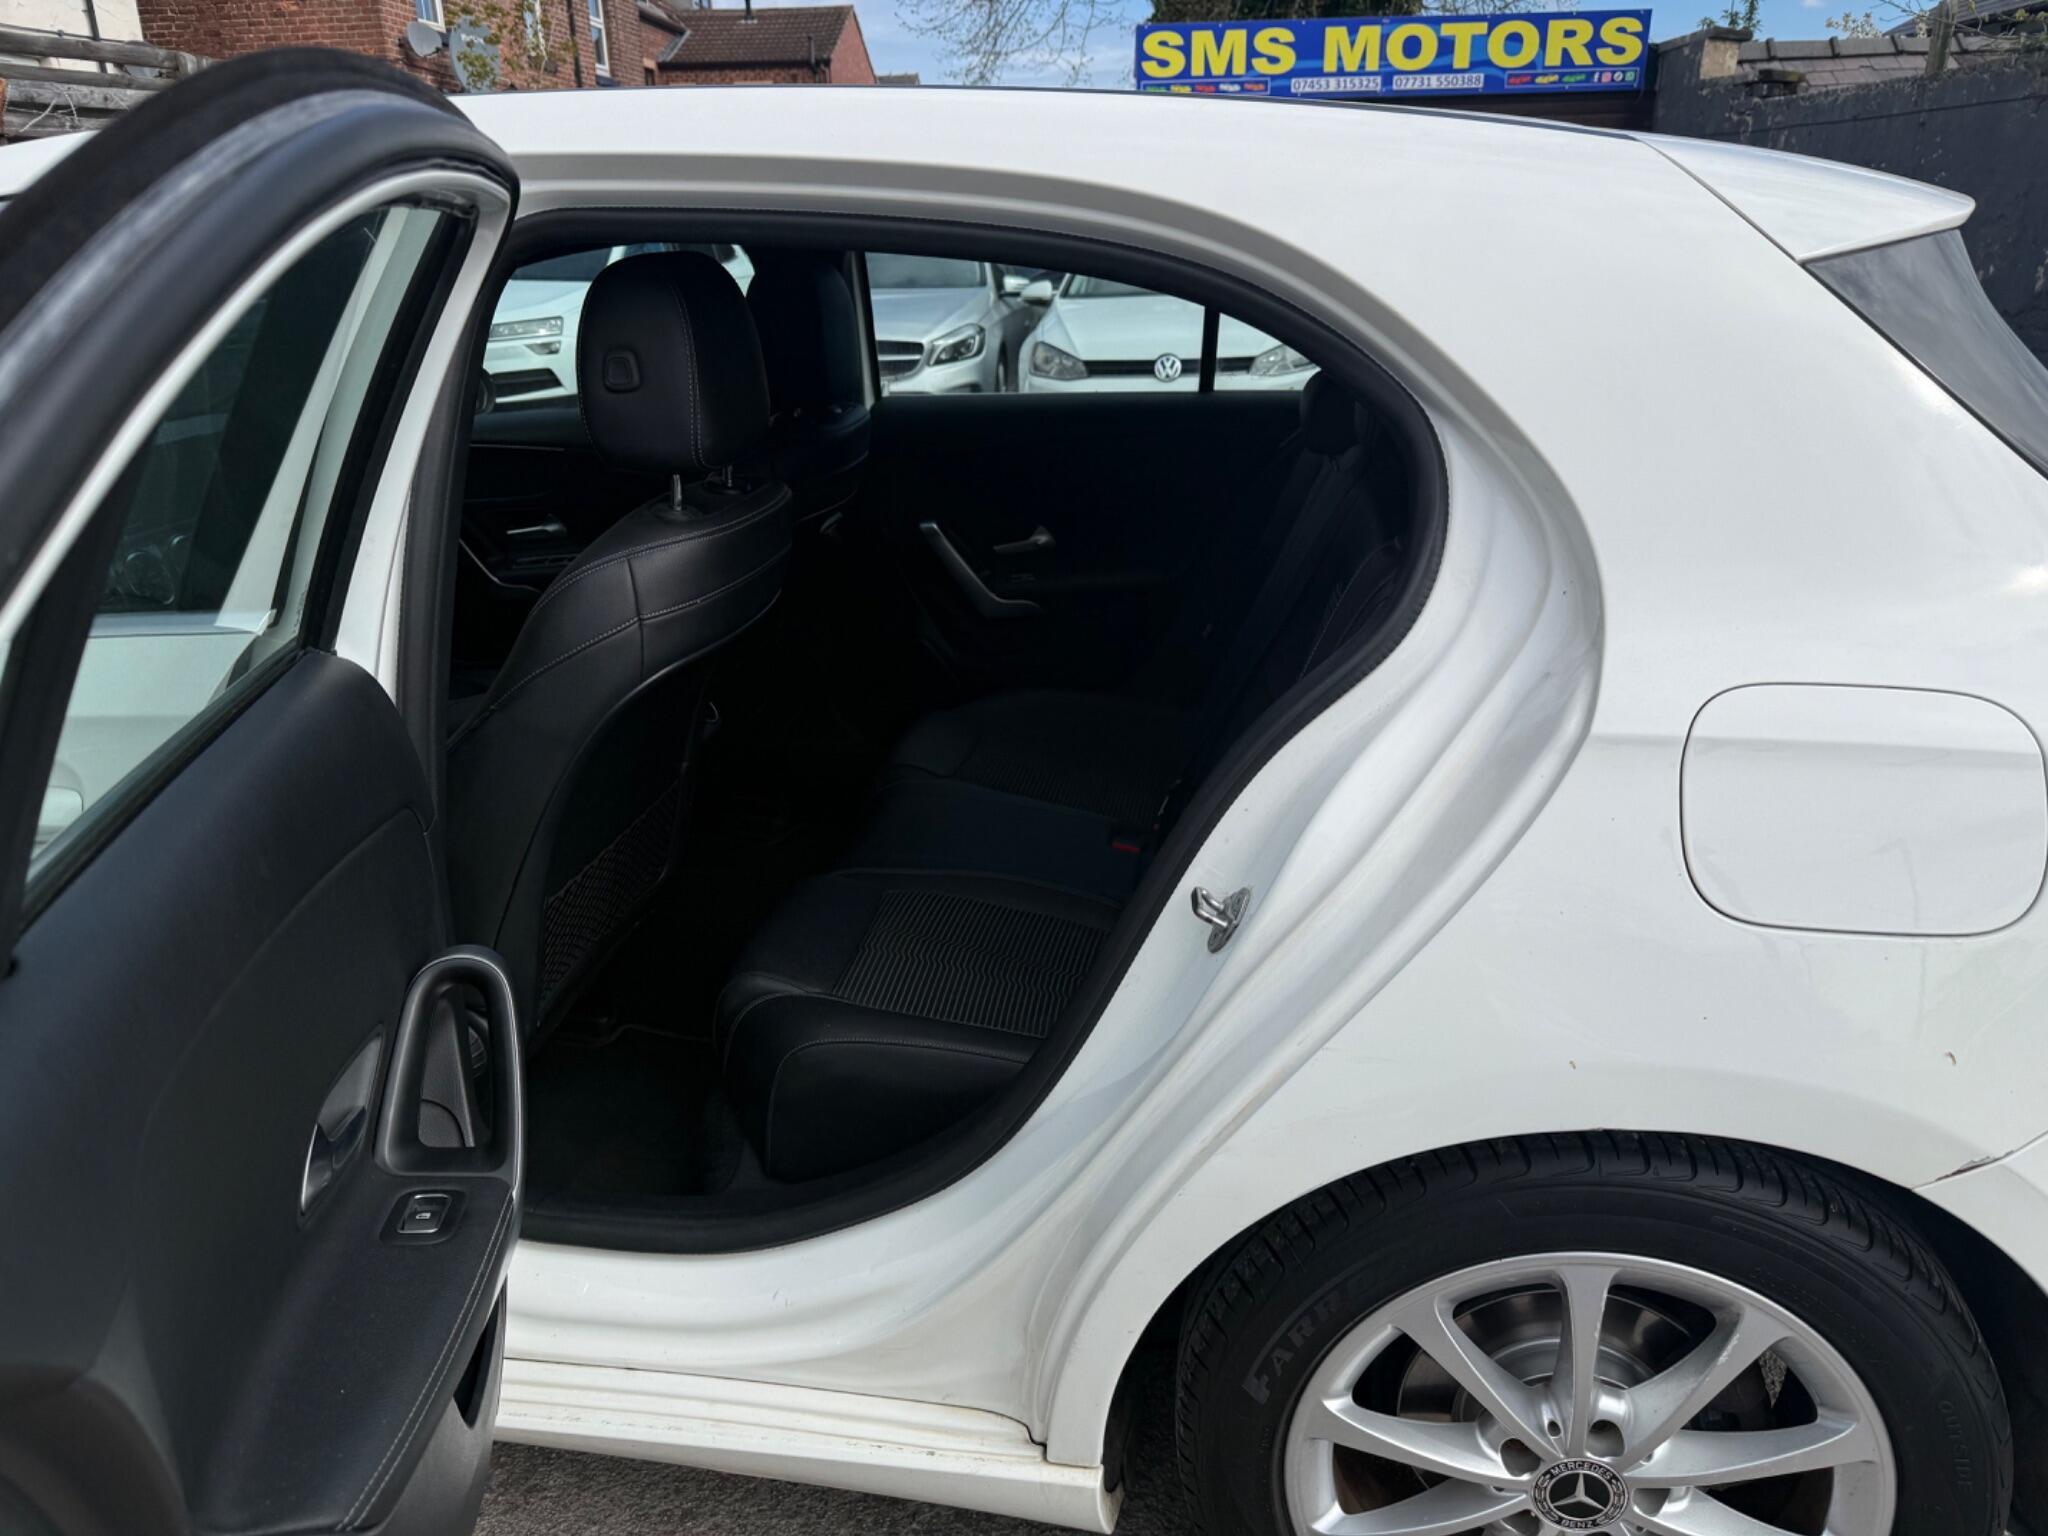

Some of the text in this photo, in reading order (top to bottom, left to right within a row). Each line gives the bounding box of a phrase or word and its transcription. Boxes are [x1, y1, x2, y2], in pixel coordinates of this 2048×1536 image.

[1141, 17, 1643, 77] SMS MOTORS
[1293, 76, 1379, 91] 07453 315325
[1394, 73, 1481, 88] 07731 550388
[1550, 1461, 1613, 1480] MERCEDES
[1561, 1519, 1595, 1528] BENZ
